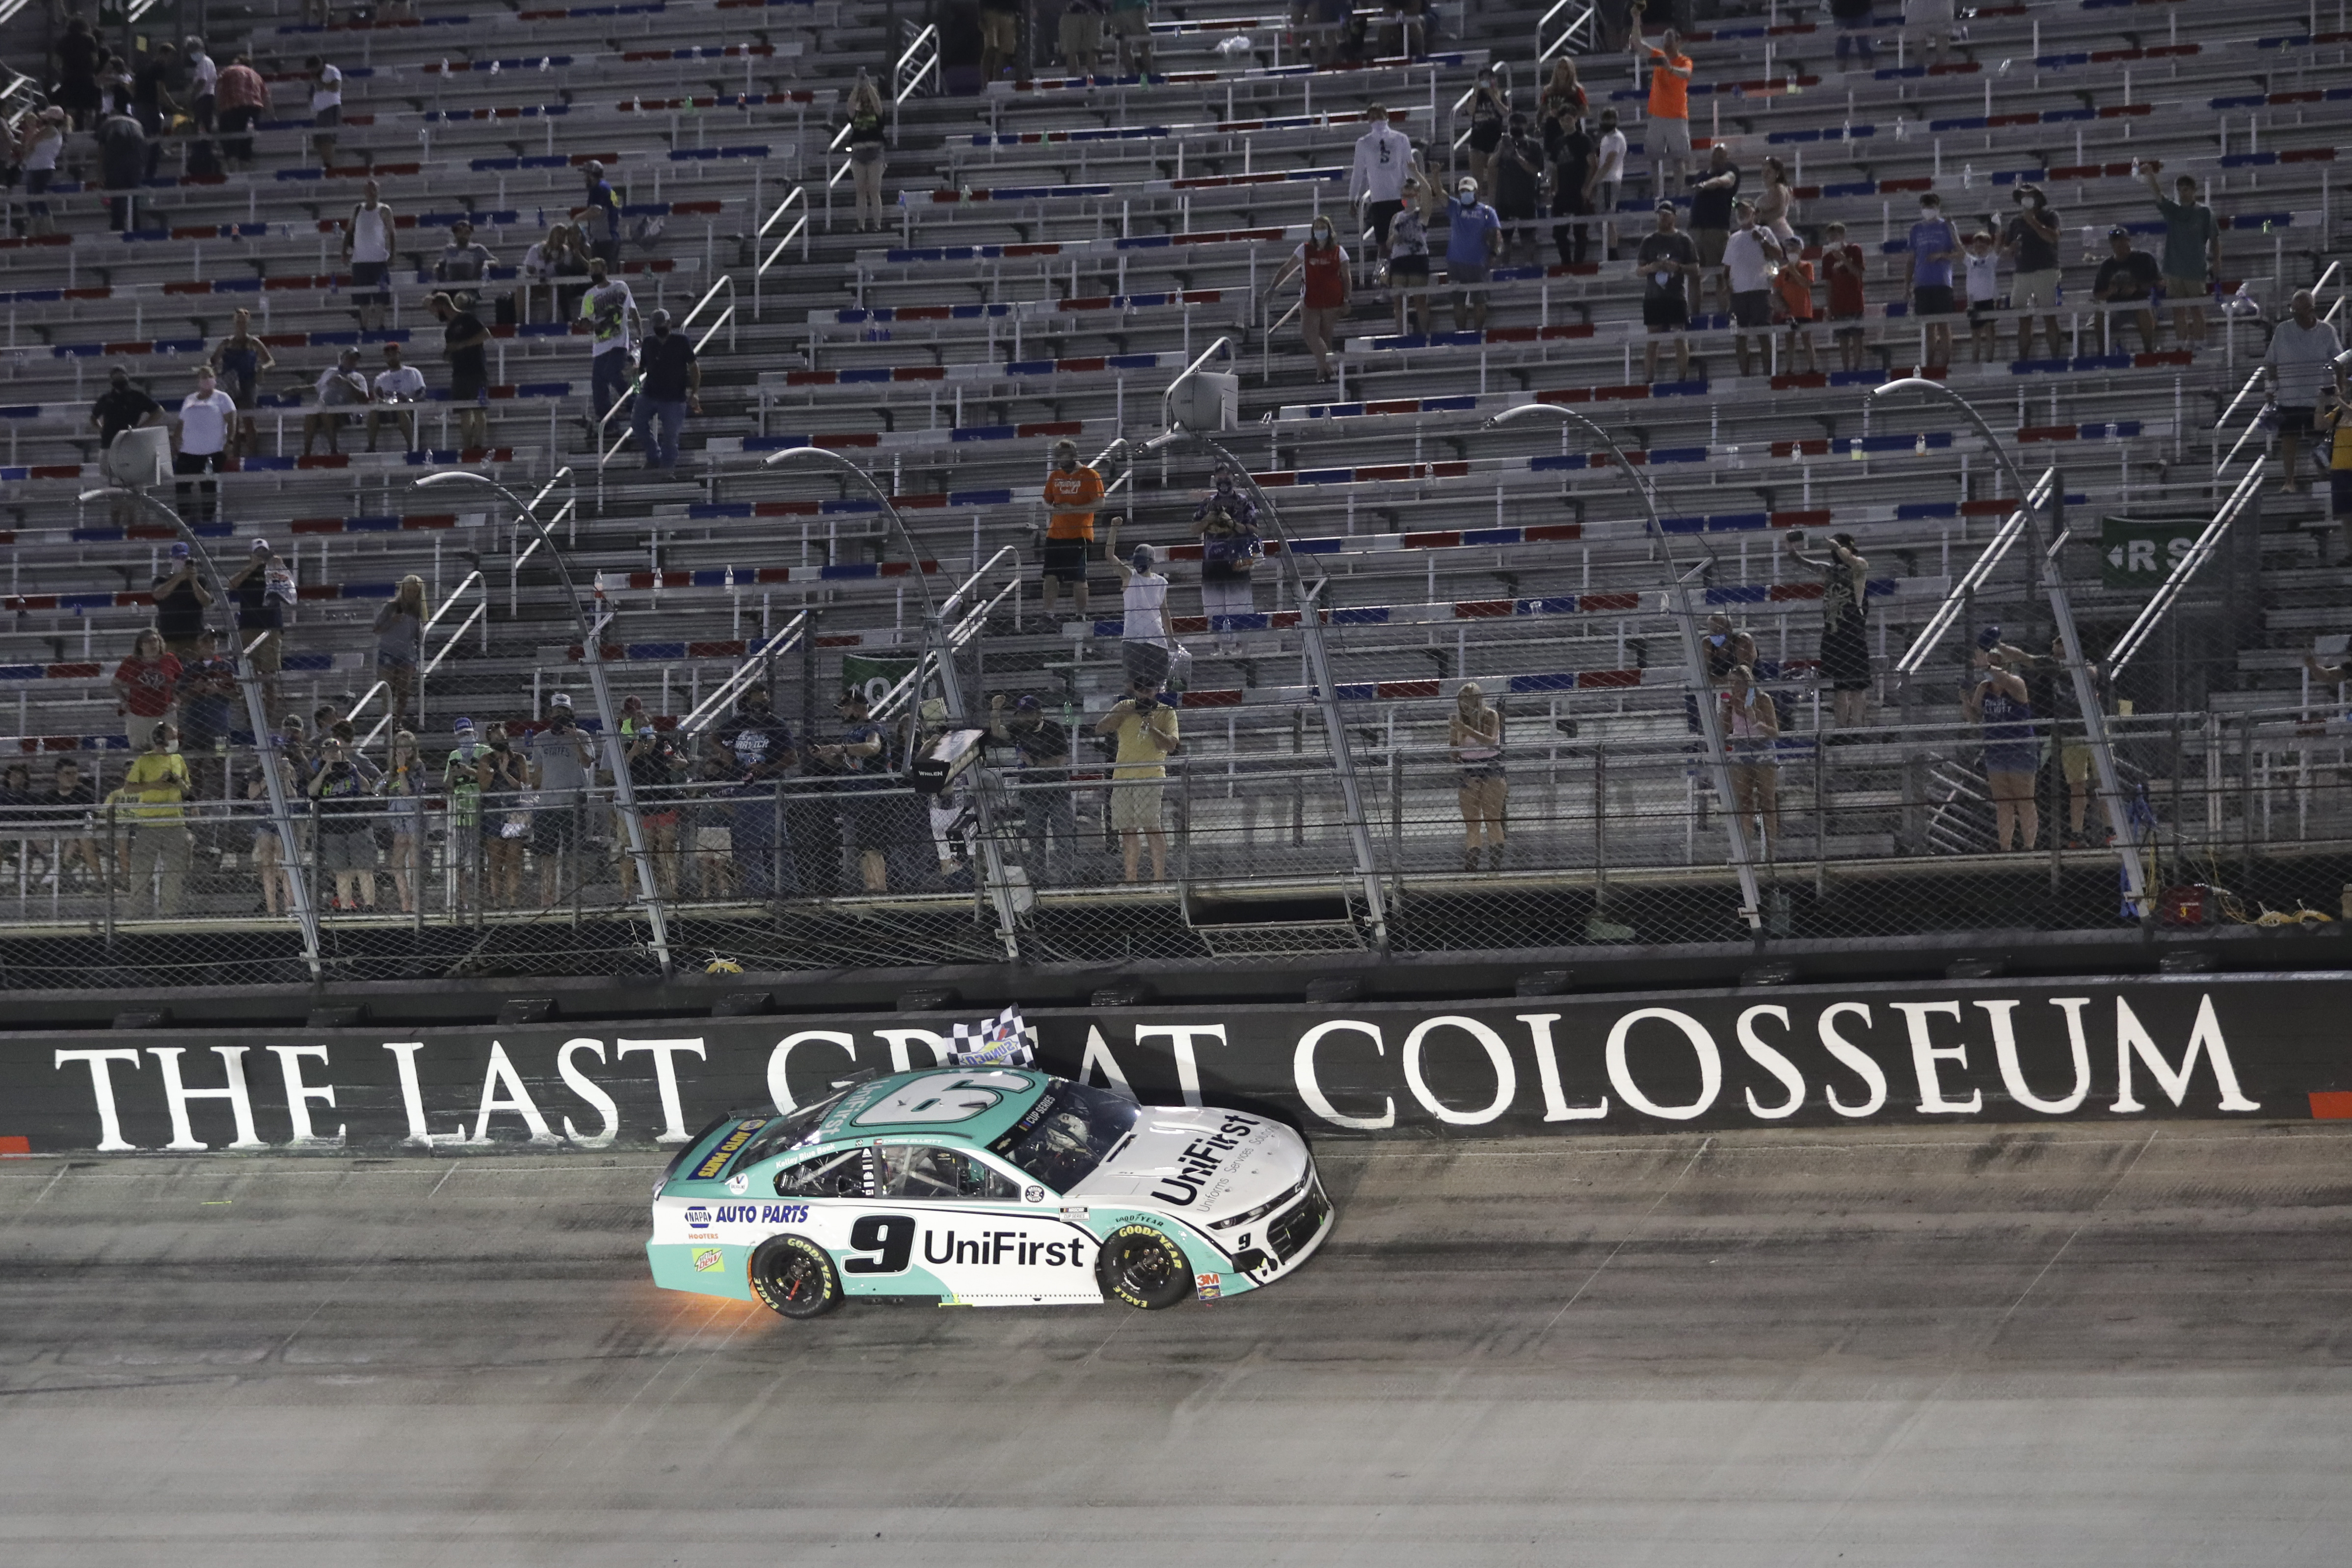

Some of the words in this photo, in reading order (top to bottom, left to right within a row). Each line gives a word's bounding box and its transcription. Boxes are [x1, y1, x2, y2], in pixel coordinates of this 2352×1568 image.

[2128, 540, 2157, 572] R
[862, 676, 890, 709] Q
[55, 1044, 346, 1151] THE
[383, 1036, 706, 1148] LAST
[767, 1023, 1228, 1118] GAT
[1293, 993, 2261, 1130] COLOSSEUM
[1025, 1109, 1040, 1124] CUP
[1035, 1094, 1056, 1115] SERIES
[775, 1157, 798, 1169] Kelley
[799, 1149, 816, 1162] Blue
[817, 1143, 835, 1155] Book
[1150, 1115, 1261, 1206] UniFirst
[1197, 1178, 1229, 1212] Uniforms
[1224, 1147, 1254, 1173] Services
[689, 1212, 708, 1222] NAPA
[716, 1206, 757, 1223] AUTO
[761, 1205, 809, 1223] PARTS
[841, 1214, 917, 1277] 9
[924, 1230, 1084, 1267] UniFirst
[1119, 1225, 1182, 1269] GOODYEAR
[1238, 1232, 1251, 1250] 9
[787, 1238, 832, 1299] GOODYEAR
[1197, 1274, 1219, 1286] 3M
[753, 1277, 779, 1310] EAGLE
[1113, 1285, 1148, 1308] EAGLE
